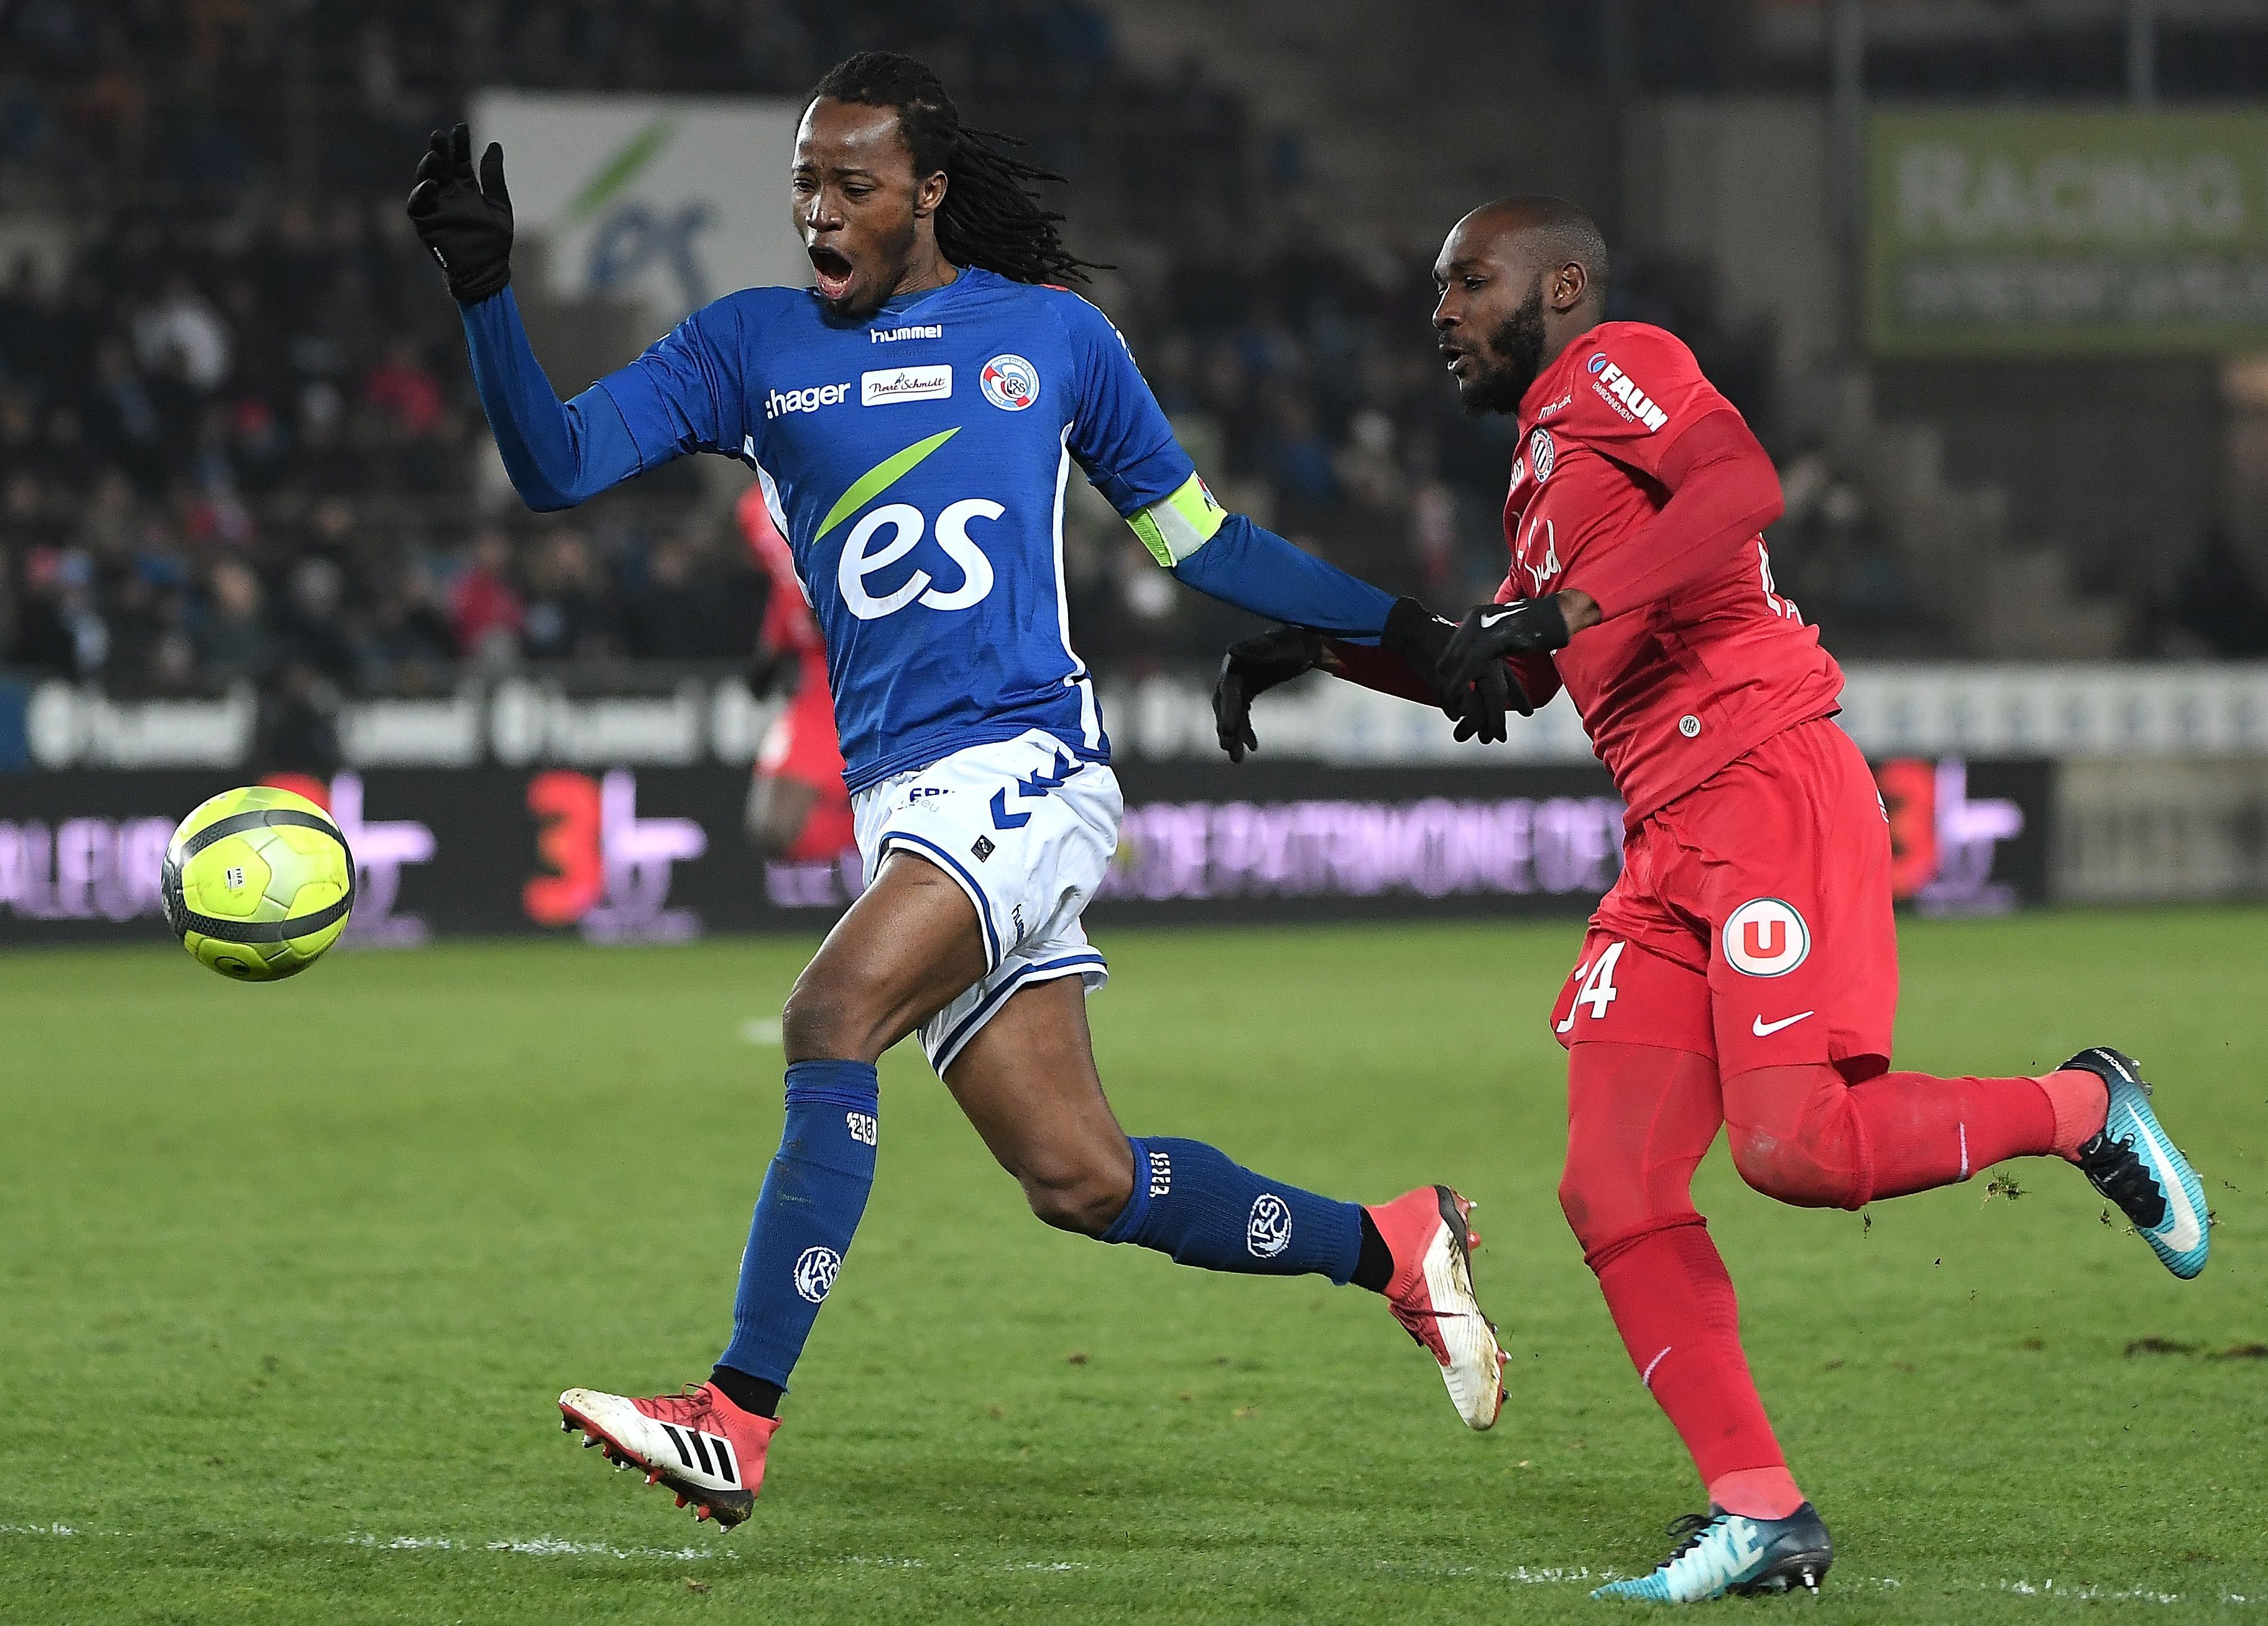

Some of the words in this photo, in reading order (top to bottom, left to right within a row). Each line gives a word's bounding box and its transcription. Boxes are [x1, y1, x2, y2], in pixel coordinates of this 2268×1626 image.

[870, 324, 943, 344] hummel
[901, 377, 946, 390] Schmidt
[1598, 362, 1669, 433] FAUN
[837, 498, 1006, 620] es
[1743, 921, 1786, 958] U
